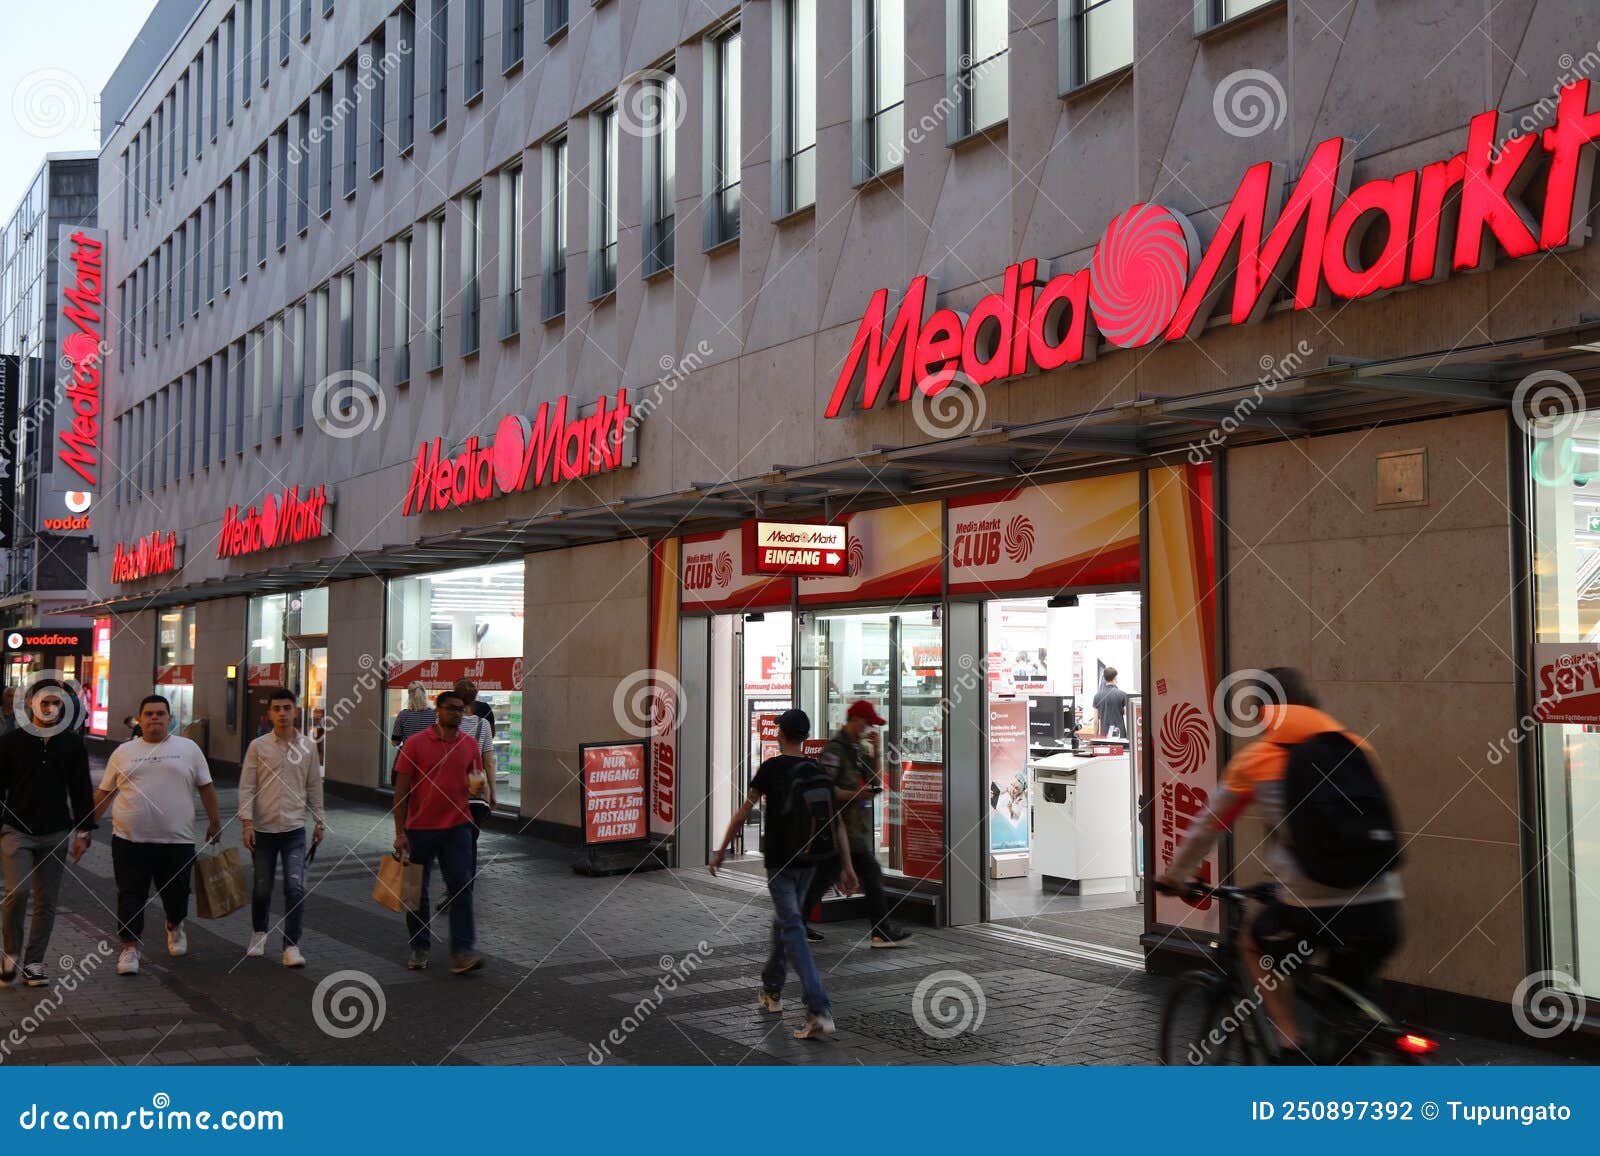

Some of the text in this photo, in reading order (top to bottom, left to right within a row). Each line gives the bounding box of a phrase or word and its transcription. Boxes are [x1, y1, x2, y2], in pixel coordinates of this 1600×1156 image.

[824, 78, 1600, 419] Media Markt
[58, 230, 102, 486] Media Markt
[402, 388, 631, 517] Media Markt
[216, 483, 326, 560] Media Markt
[956, 518, 1001, 535] Media Markt
[766, 530, 838, 544] Media Markt
[111, 529, 176, 584] Media Markt
[764, 549, 821, 566] EINGANG
[953, 531, 1001, 569] CLUB
[684, 562, 713, 590] CLUB
[26, 633, 79, 645] vodafone
[744, 683, 770, 691] Samsung
[603, 755, 626, 769] NUR
[589, 768, 640, 784] EINGANG!
[658, 742, 674, 823] CLUB
[588, 796, 643, 811] BITTE 1,5m
[1160, 781, 1174, 837] Markt
[592, 809, 640, 825] ABSTAND
[597, 822, 637, 838] HALTEN
